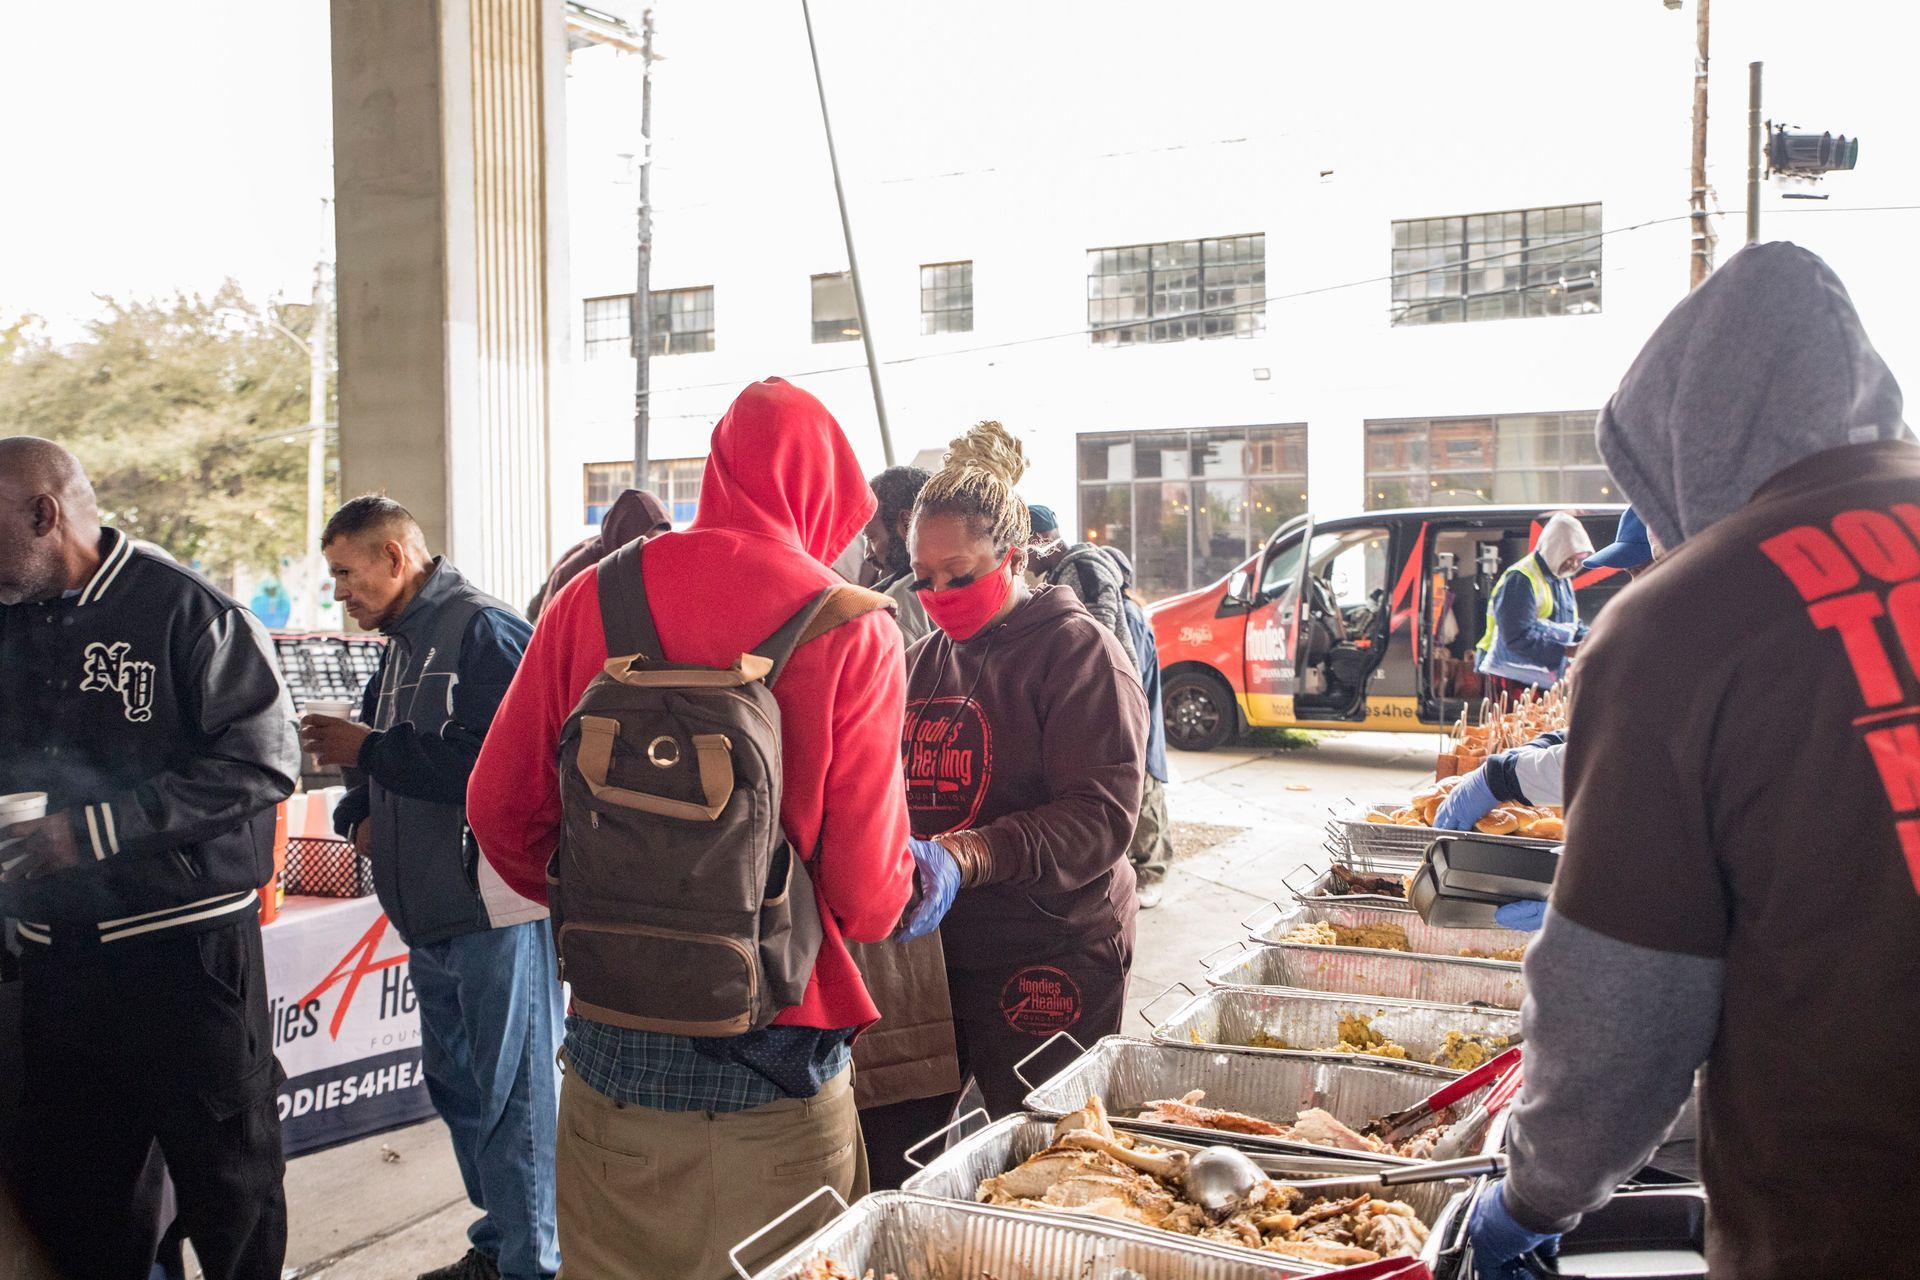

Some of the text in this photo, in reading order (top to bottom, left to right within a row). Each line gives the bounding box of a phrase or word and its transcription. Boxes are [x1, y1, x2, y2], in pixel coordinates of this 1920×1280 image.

[1758, 503, 1920, 601] DO
[1245, 619, 1286, 661] Hoodies
[1366, 704, 1419, 718] es4he
[1019, 977, 1062, 995] Hoodies
[1030, 993, 1073, 1014] Healing
